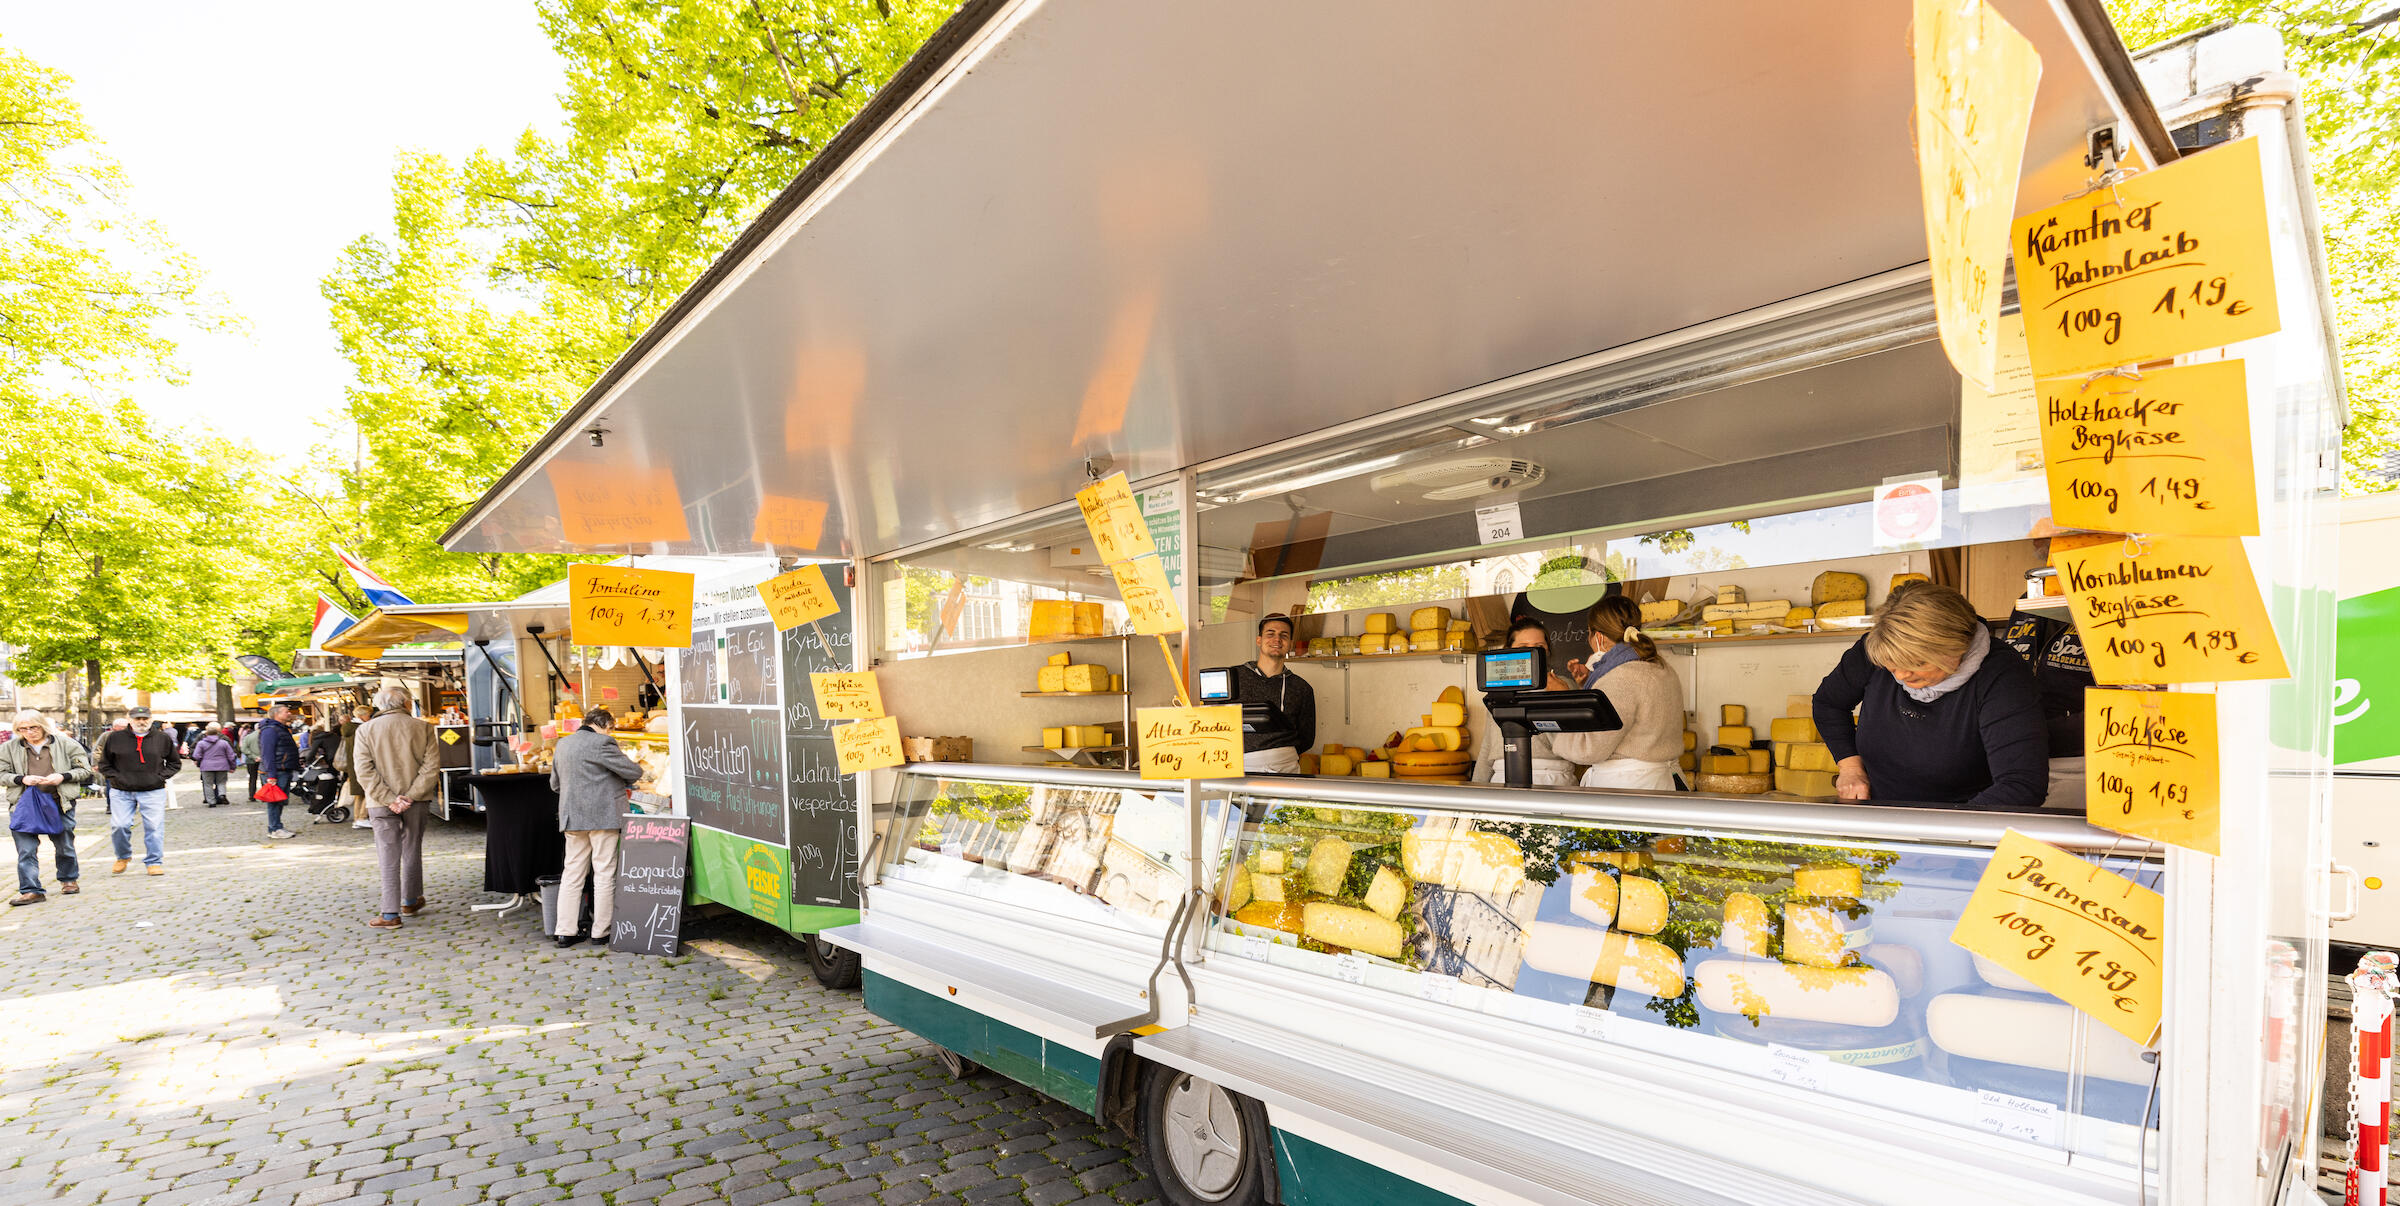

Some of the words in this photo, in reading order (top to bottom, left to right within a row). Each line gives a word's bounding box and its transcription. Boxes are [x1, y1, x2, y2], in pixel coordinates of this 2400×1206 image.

[2028, 201, 2161, 265] Kärntner
[2050, 231, 2198, 290] Rahmlaib
[2058, 308, 2121, 345] 100g
[2152, 277, 2227, 319] 1,19
[2224, 300, 2252, 316] €
[2049, 396, 2184, 426] Holzhacker
[2071, 424, 2185, 464] Bergkäse
[2066, 478, 2118, 513] 100g
[2140, 477, 2199, 504] 1,49
[1492, 527, 1510, 539] 204
[587, 577, 662, 598] Fontalino
[2067, 559, 2213, 592] Kornblumen
[587, 606, 624, 626] 100g
[637, 607, 675, 625] 1,39
[2086, 594, 2184, 628] Bergkäse
[1152, 752, 1183, 771] 100g
[2096, 771, 2133, 814] 100g
[2149, 781, 2188, 807] 1,69
[626, 820, 643, 839] Top
[621, 850, 685, 883] Leonardo
[747, 865, 781, 899] PEISKE
[2007, 855, 2157, 941] Parmesan
[1994, 912, 2055, 960] 100g
[2075, 950, 2137, 991] 1,99
